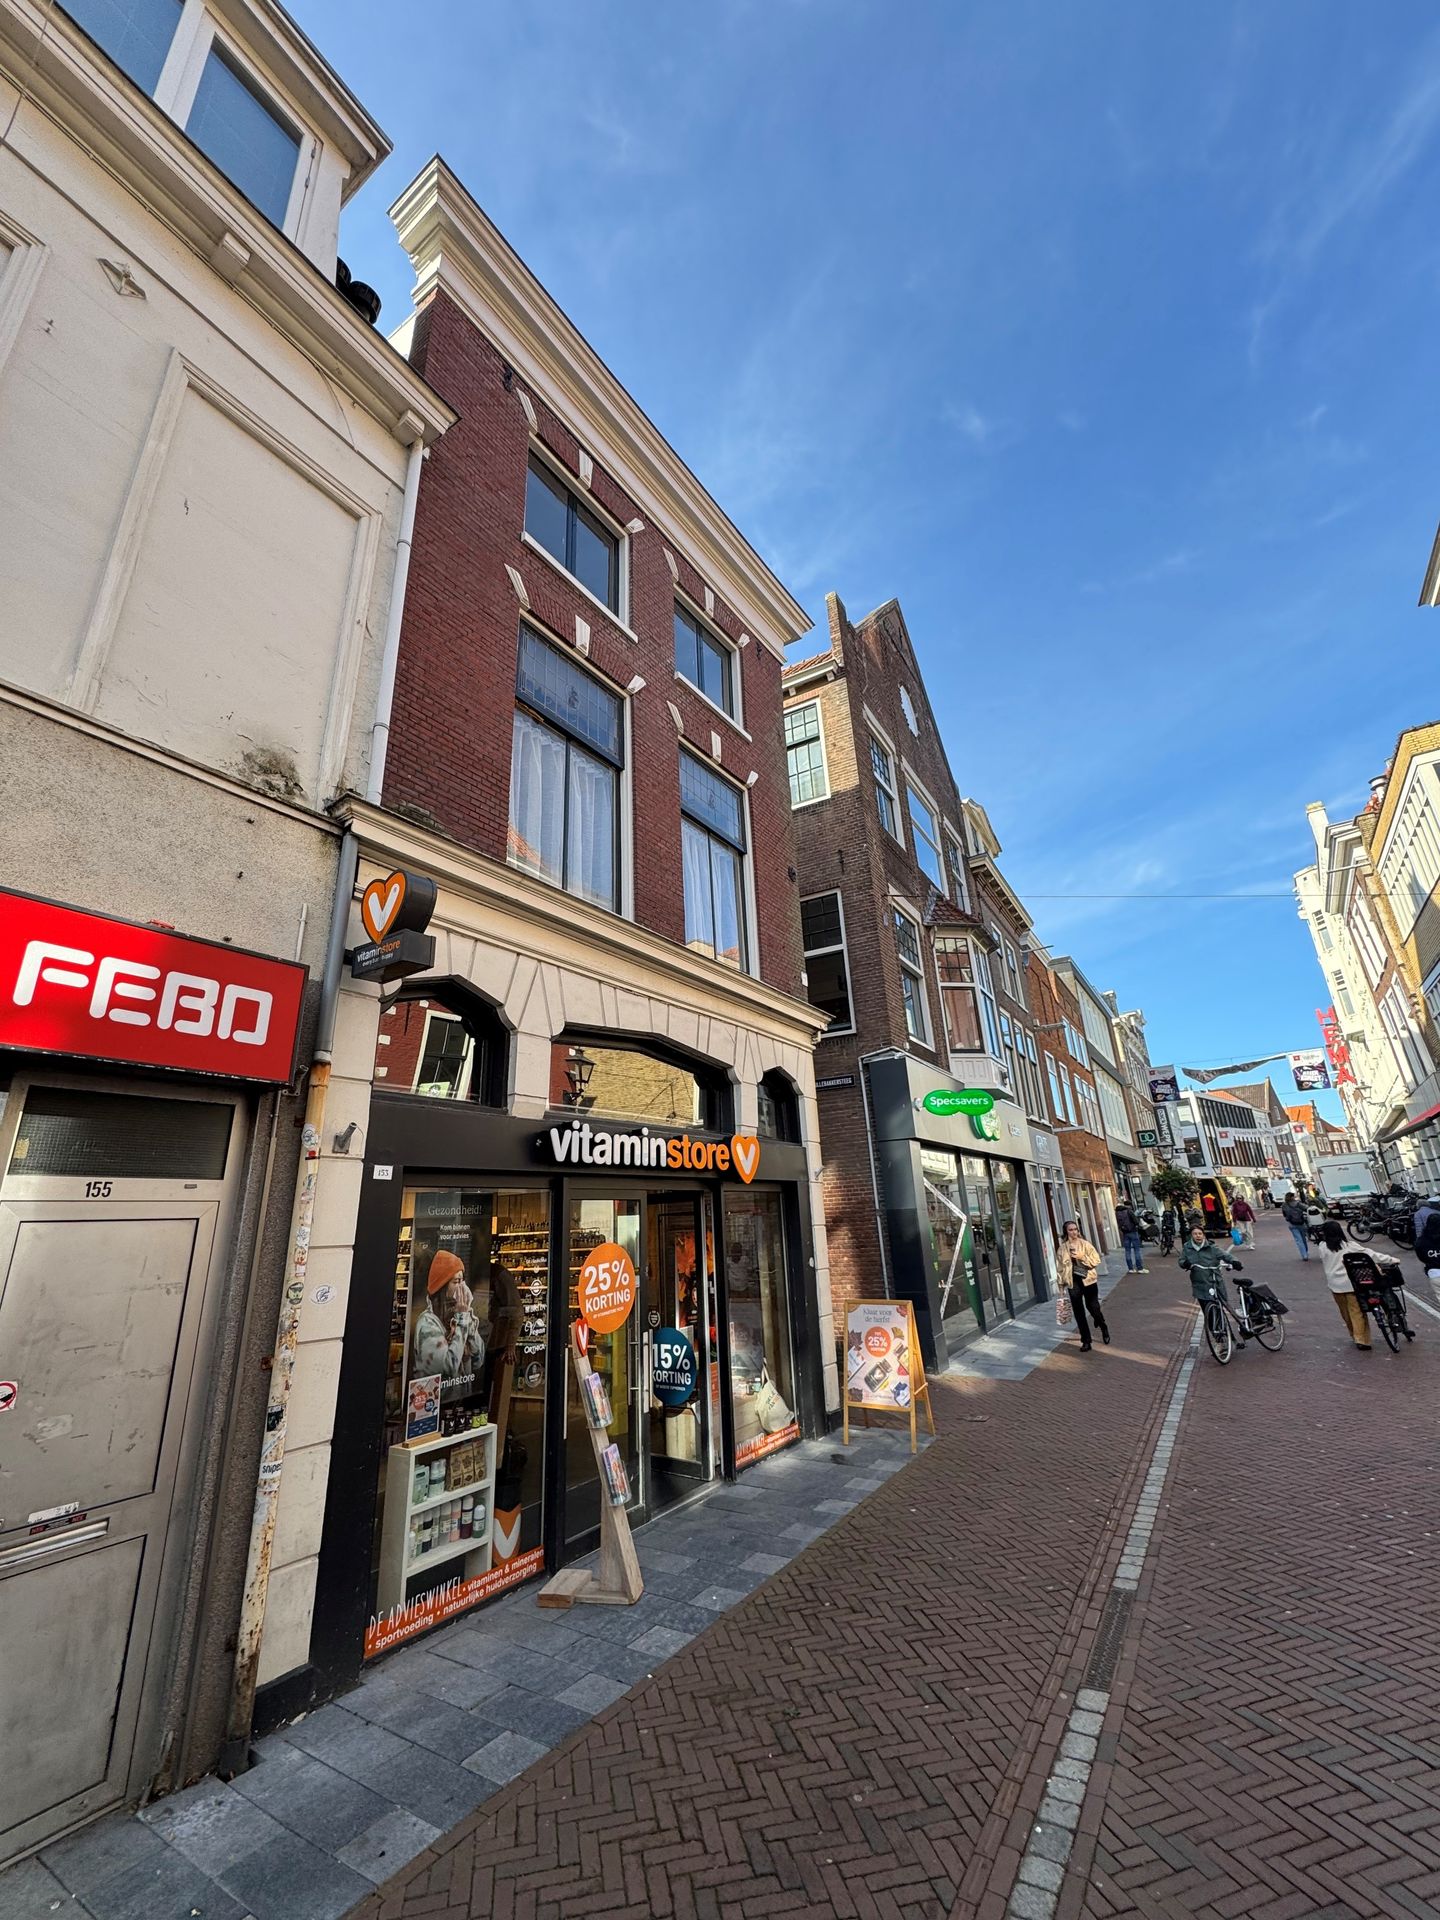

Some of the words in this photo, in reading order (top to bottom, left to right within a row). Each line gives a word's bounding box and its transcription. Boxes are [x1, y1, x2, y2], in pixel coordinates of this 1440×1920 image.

[357, 940, 400, 963] vitaminstore
[12, 940, 274, 1046] FEBO
[1315, 1006, 1358, 1085] HEMA
[930, 1095, 989, 1107] Specsavers
[550, 1120, 729, 1170] vitaminstore
[378, 1169, 389, 1177] 153
[85, 1181, 113, 1198] 155
[428, 1205, 482, 1216] Gezondheid!
[585, 1259, 630, 1295] 25%
[585, 1288, 630, 1313] KORTING
[868, 1336, 888, 1347] 25%
[653, 1344, 691, 1371] 15%
[368, 1611, 384, 1640] DE
[387, 1576, 463, 1631] ADVIESWINKEL
[467, 1568, 503, 1592] vitaminen
[504, 1564, 510, 1574] &
[512, 1549, 545, 1570] mineralen
[375, 1613, 434, 1649] sportvoeding
[443, 1589, 485, 1615] natuurlijke
[485, 1562, 537, 1594] huidverzorging
